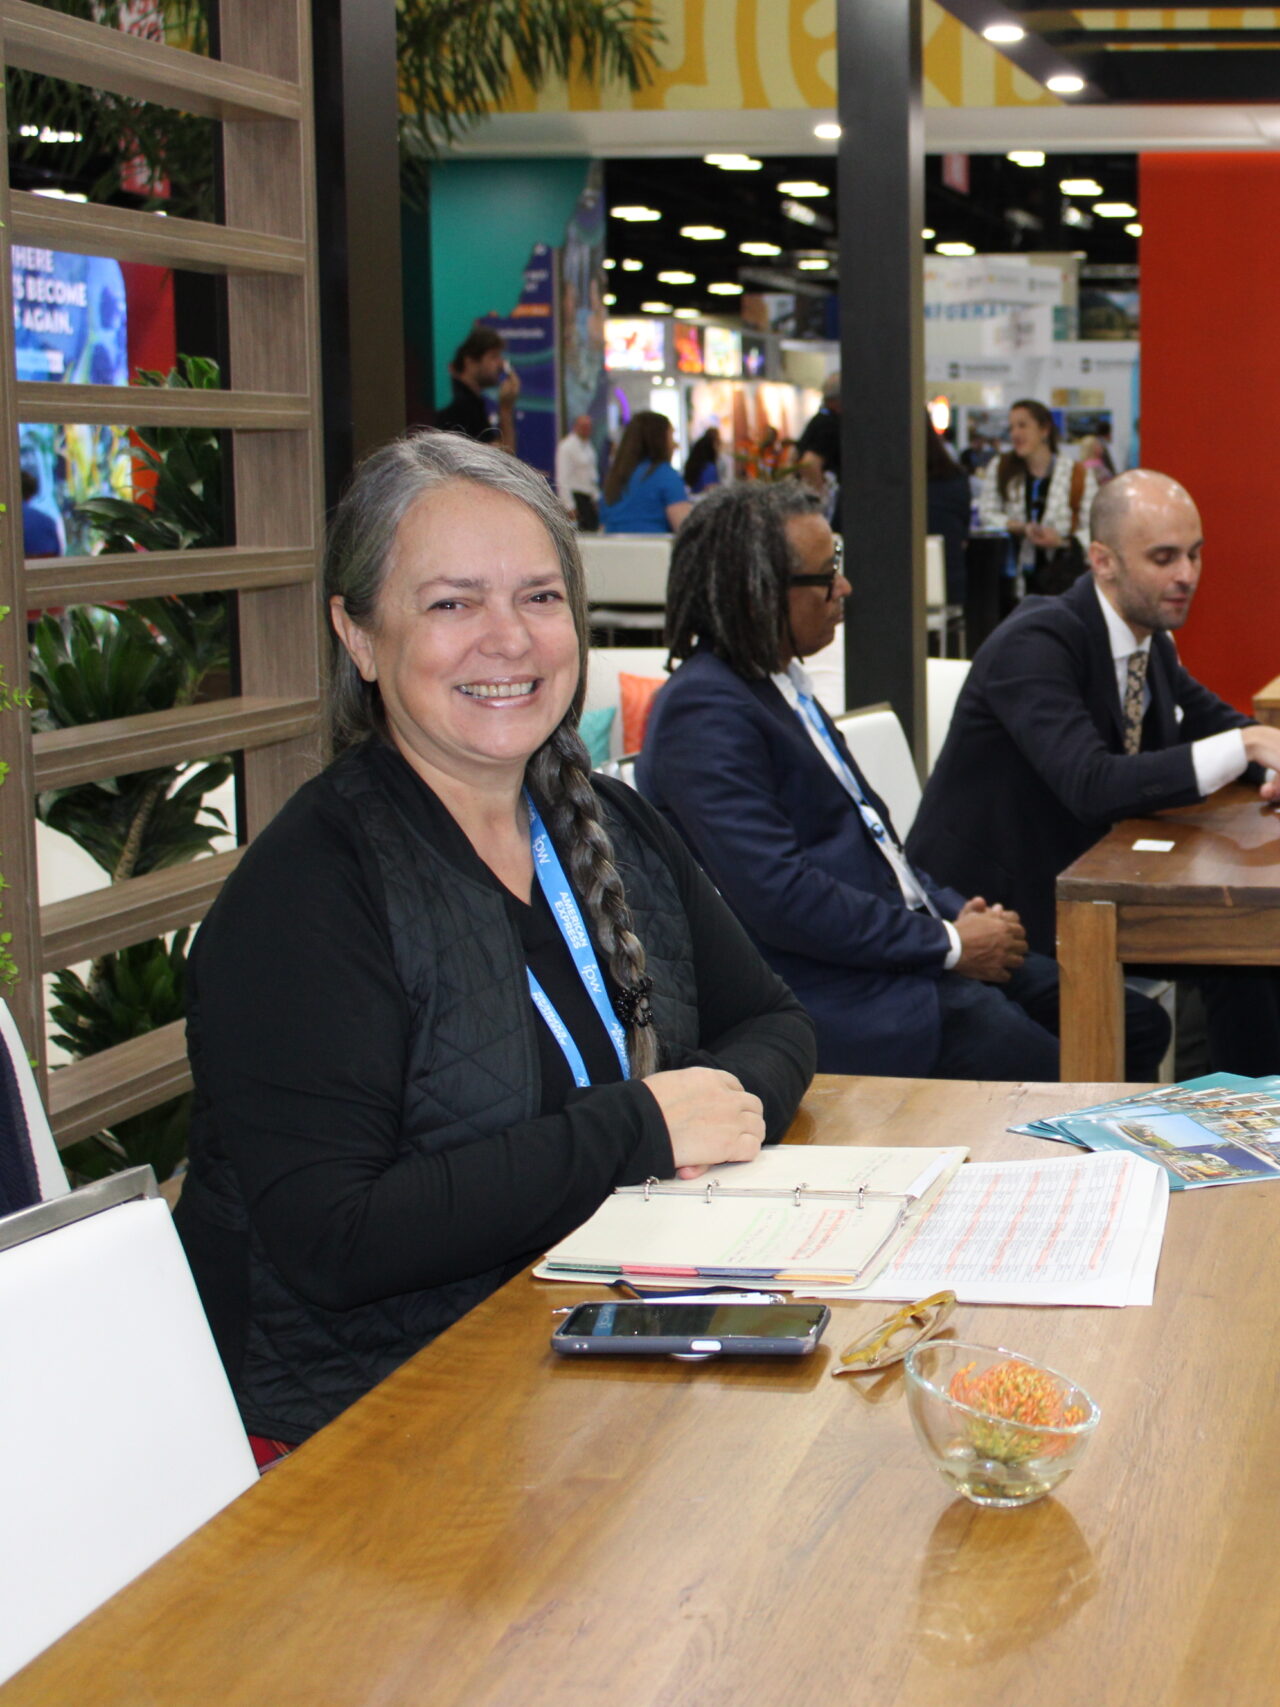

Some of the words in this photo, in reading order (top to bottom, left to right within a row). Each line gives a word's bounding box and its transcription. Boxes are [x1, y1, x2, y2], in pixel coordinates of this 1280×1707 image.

[12, 245, 53, 273] HERE
[26, 277, 87, 307] BECOME
[23, 308, 73, 334] AGAIN.
[532, 833, 551, 865] ipw
[554, 900, 582, 950] EXPRESS
[560, 891, 588, 948] AMERICAN
[581, 963, 602, 993] ipw
